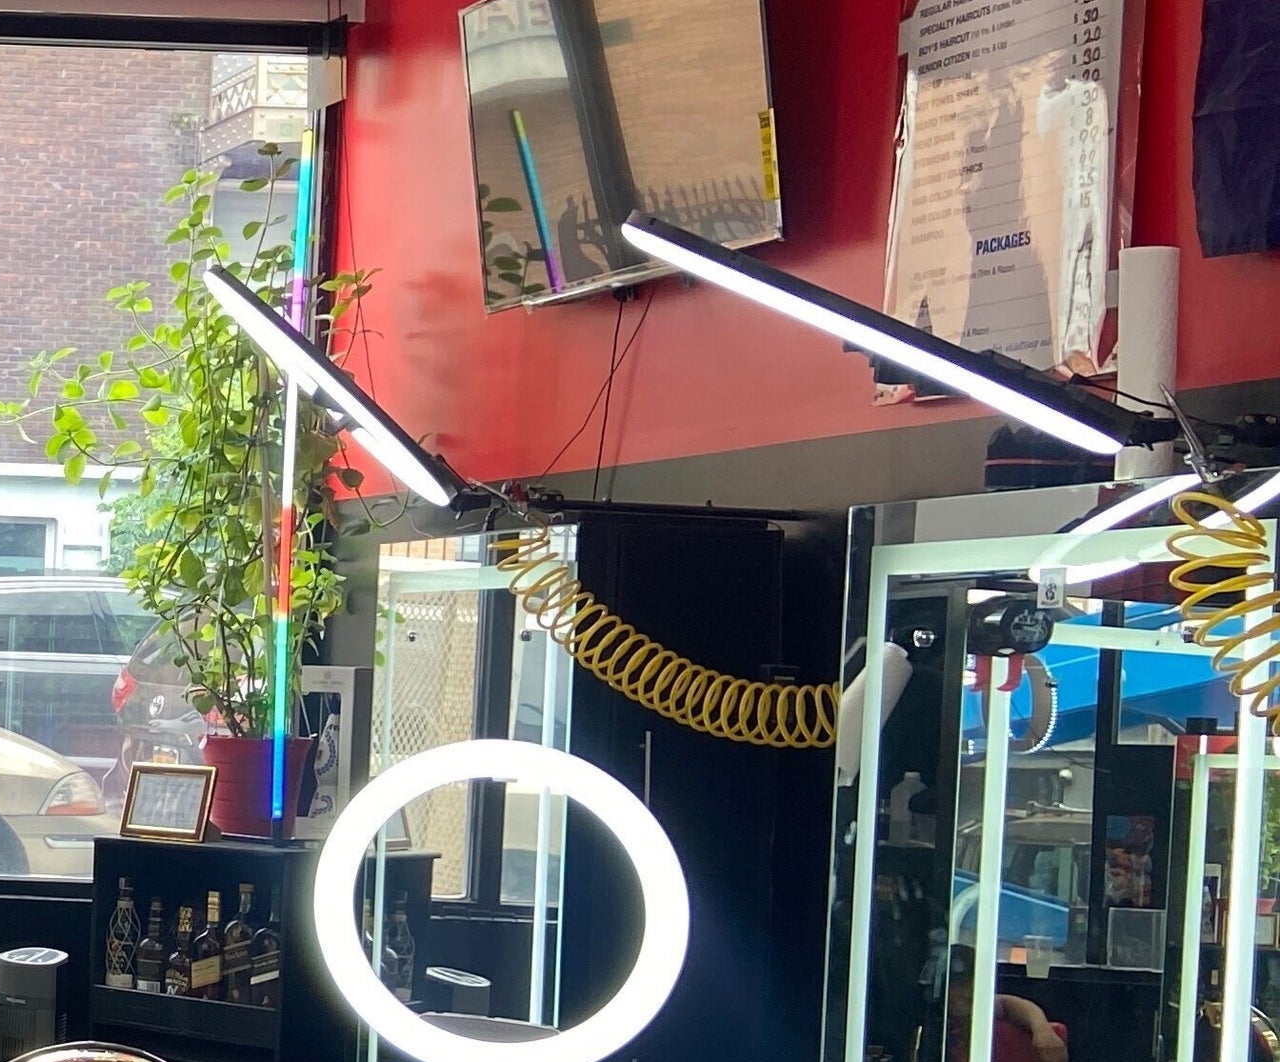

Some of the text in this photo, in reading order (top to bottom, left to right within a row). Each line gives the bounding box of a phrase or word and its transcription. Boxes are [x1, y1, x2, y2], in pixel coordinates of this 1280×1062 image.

[920, 1, 952, 18] REGULAR
[1083, 7, 1099, 24] 30
[920, 17, 955, 37] SPECIALTY
[956, 5, 991, 24] HAIRCUTS
[940, 31, 970, 49] HAIRCUT
[1083, 26, 1101, 44] 20
[918, 59, 942, 75] SENIOR
[943, 51, 971, 67] CITIZEN
[1083, 46, 1100, 65] 30
[975, 230, 1032, 256] PACKAGES
